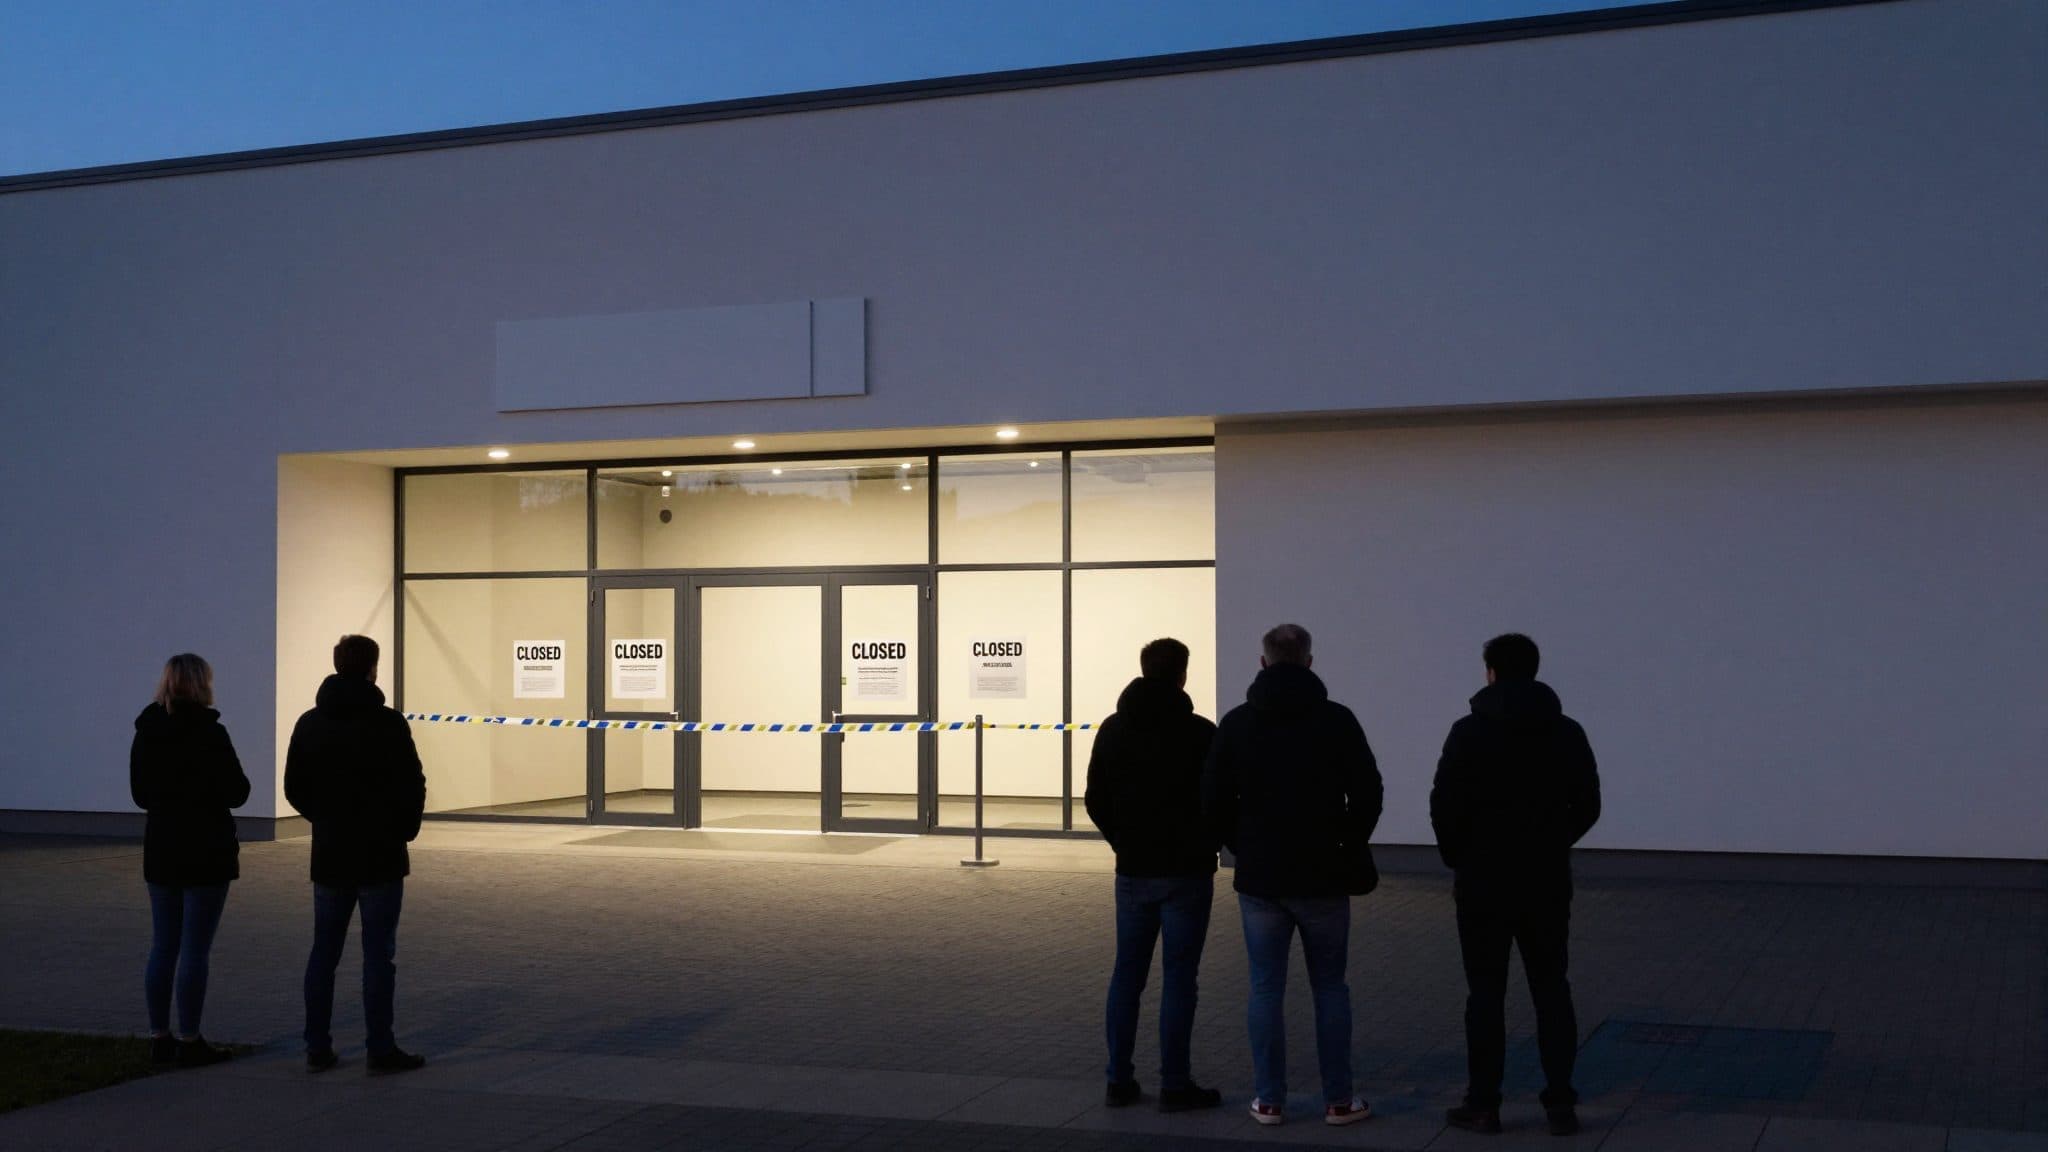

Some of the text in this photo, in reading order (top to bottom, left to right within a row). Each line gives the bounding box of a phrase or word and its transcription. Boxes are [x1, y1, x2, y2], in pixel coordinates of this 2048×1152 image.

[517, 646, 561, 660] CLOSED
[615, 644, 663, 659] CLOSED
[852, 642, 906, 660] CLOSED
[973, 642, 1022, 657] CLOSED
